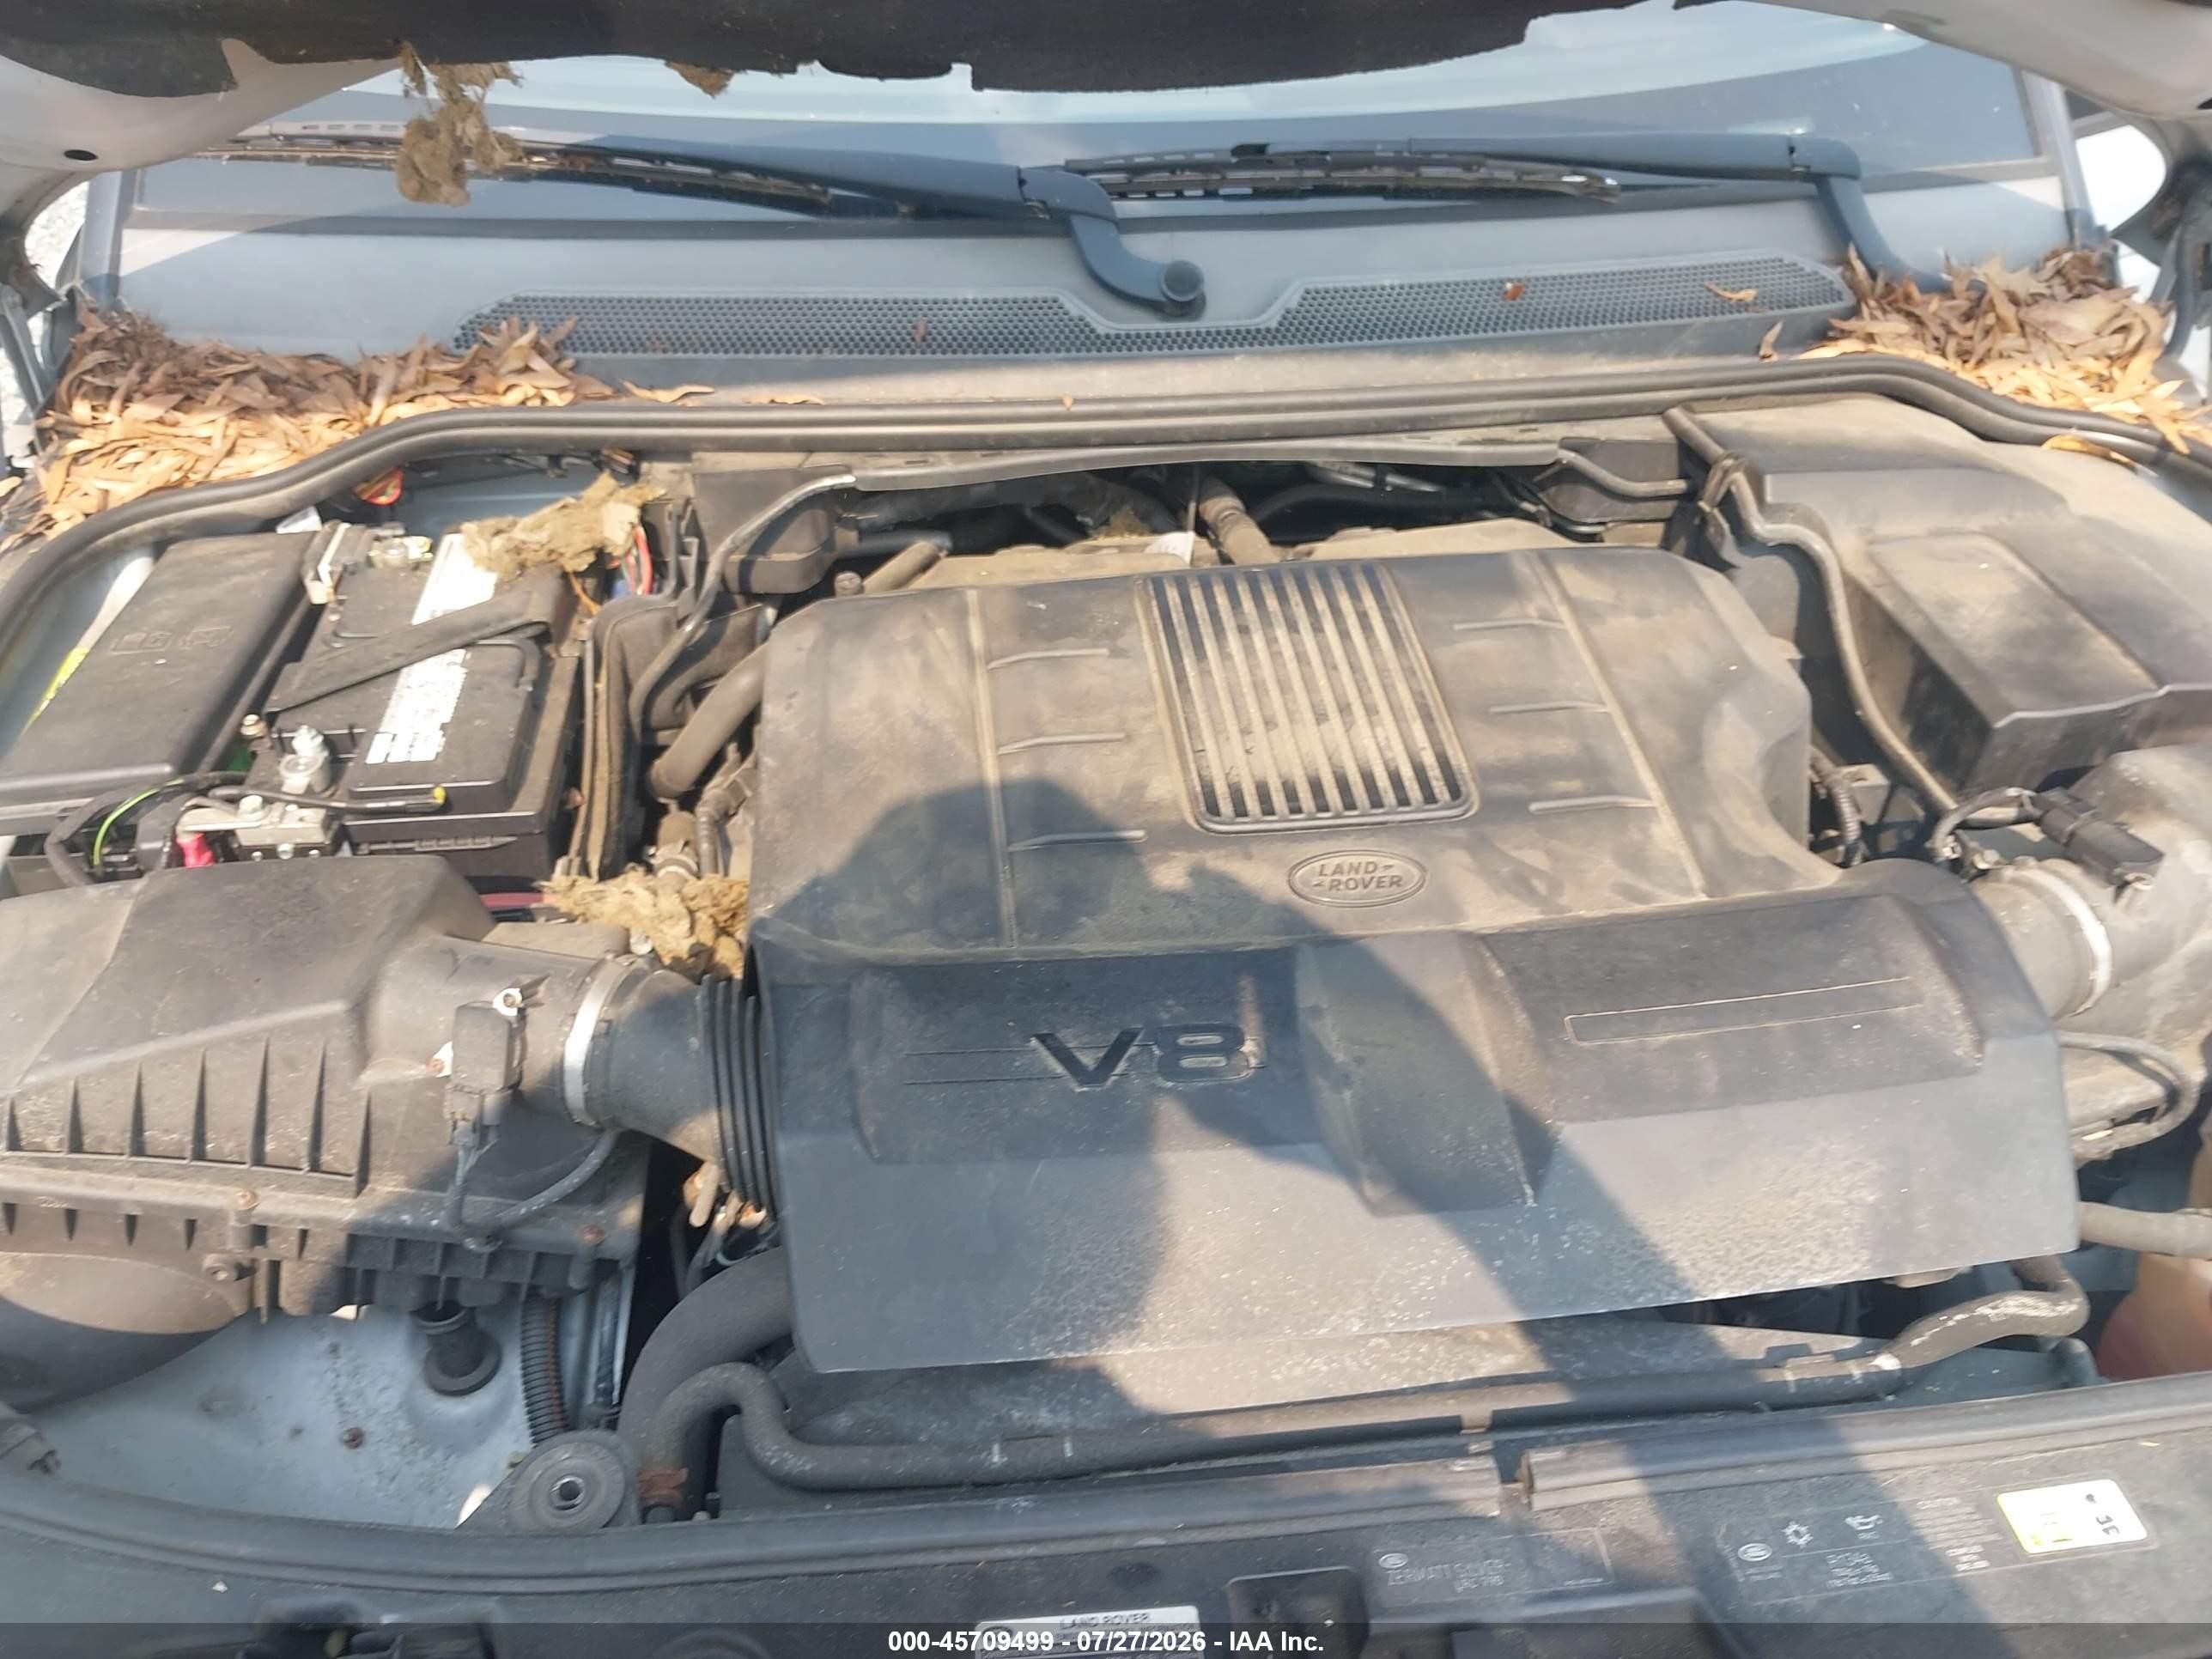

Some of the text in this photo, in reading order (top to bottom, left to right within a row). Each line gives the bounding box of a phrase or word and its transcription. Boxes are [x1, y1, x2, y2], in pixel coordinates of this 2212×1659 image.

[1318, 860, 1378, 878] LAND
[1328, 874, 1404, 892] ROVER
[1030, 1021, 1257, 1091] V8
